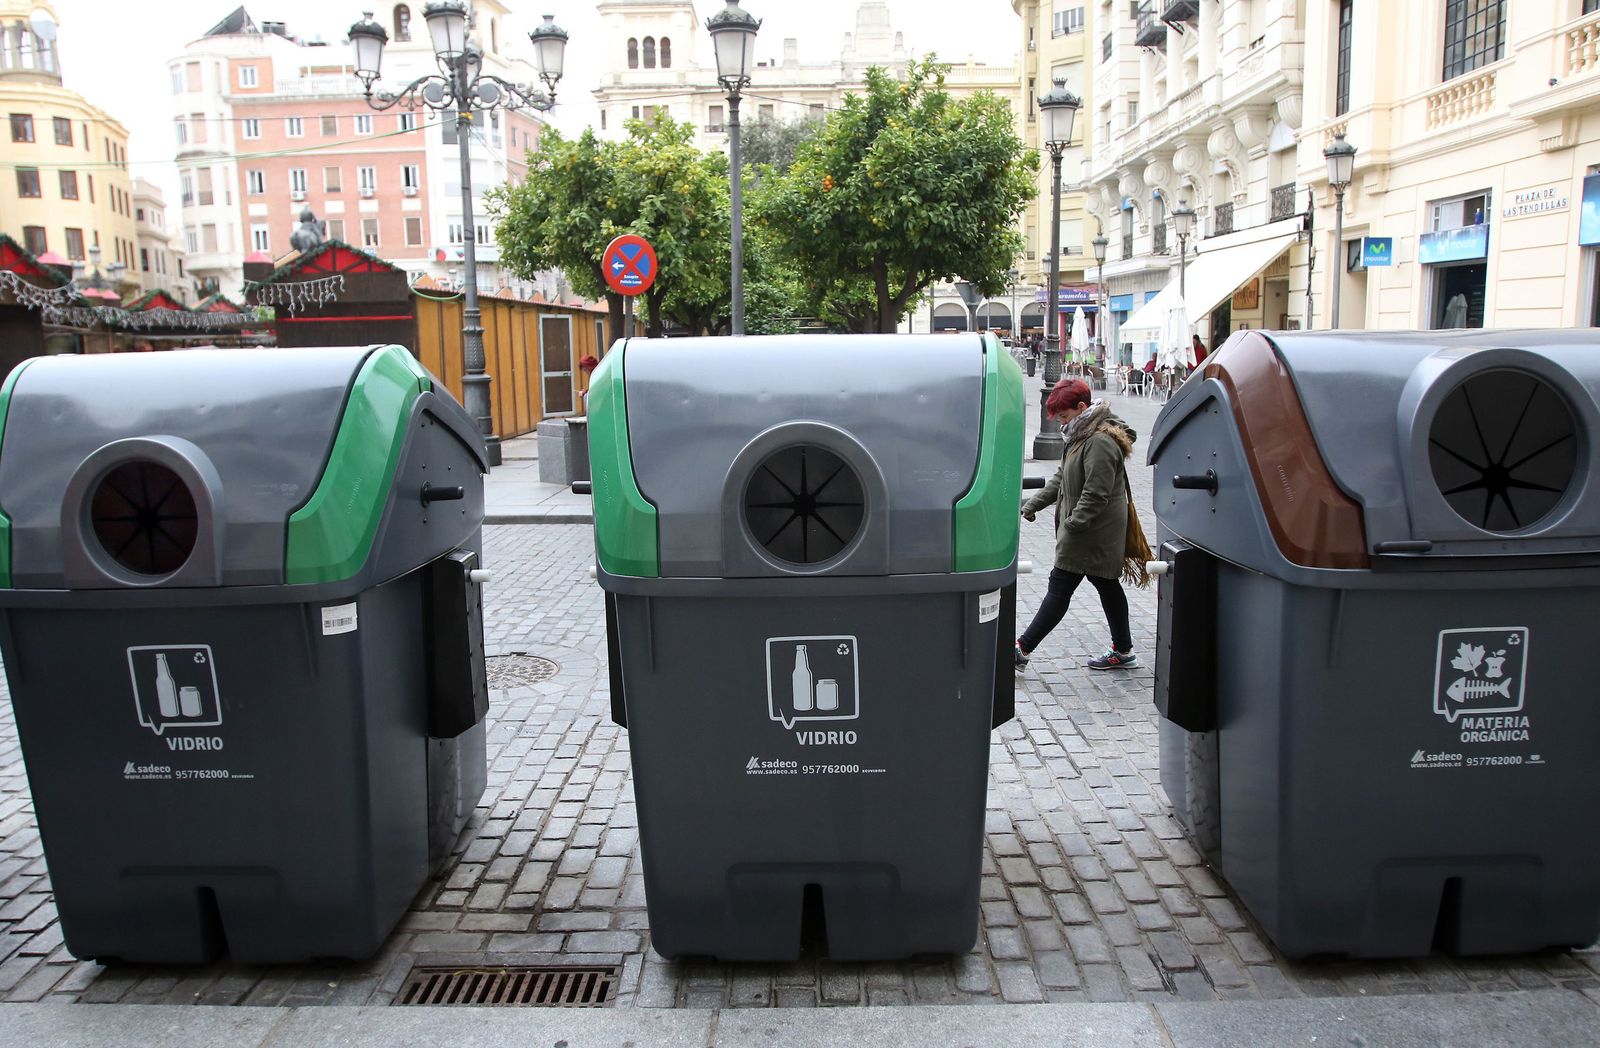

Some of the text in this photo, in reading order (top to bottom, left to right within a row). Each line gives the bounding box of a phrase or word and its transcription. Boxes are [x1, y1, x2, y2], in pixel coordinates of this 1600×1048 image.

[1515, 188, 1554, 202] PLAZA DE
[1503, 198, 1568, 217] LAS TENDILLAS
[1461, 716, 1530, 730] MATERIA
[796, 730, 858, 745] VIDRIO
[1460, 728, 1530, 743] ORGÁNICA
[166, 736, 224, 751] VIDRIO
[1427, 751, 1463, 762] sadeco
[1466, 755, 1523, 767] 957762000
[137, 763, 171, 774] sadeco
[761, 758, 798, 769] sadeco
[802, 764, 860, 774] 957762000
[175, 769, 229, 779] 957762000
